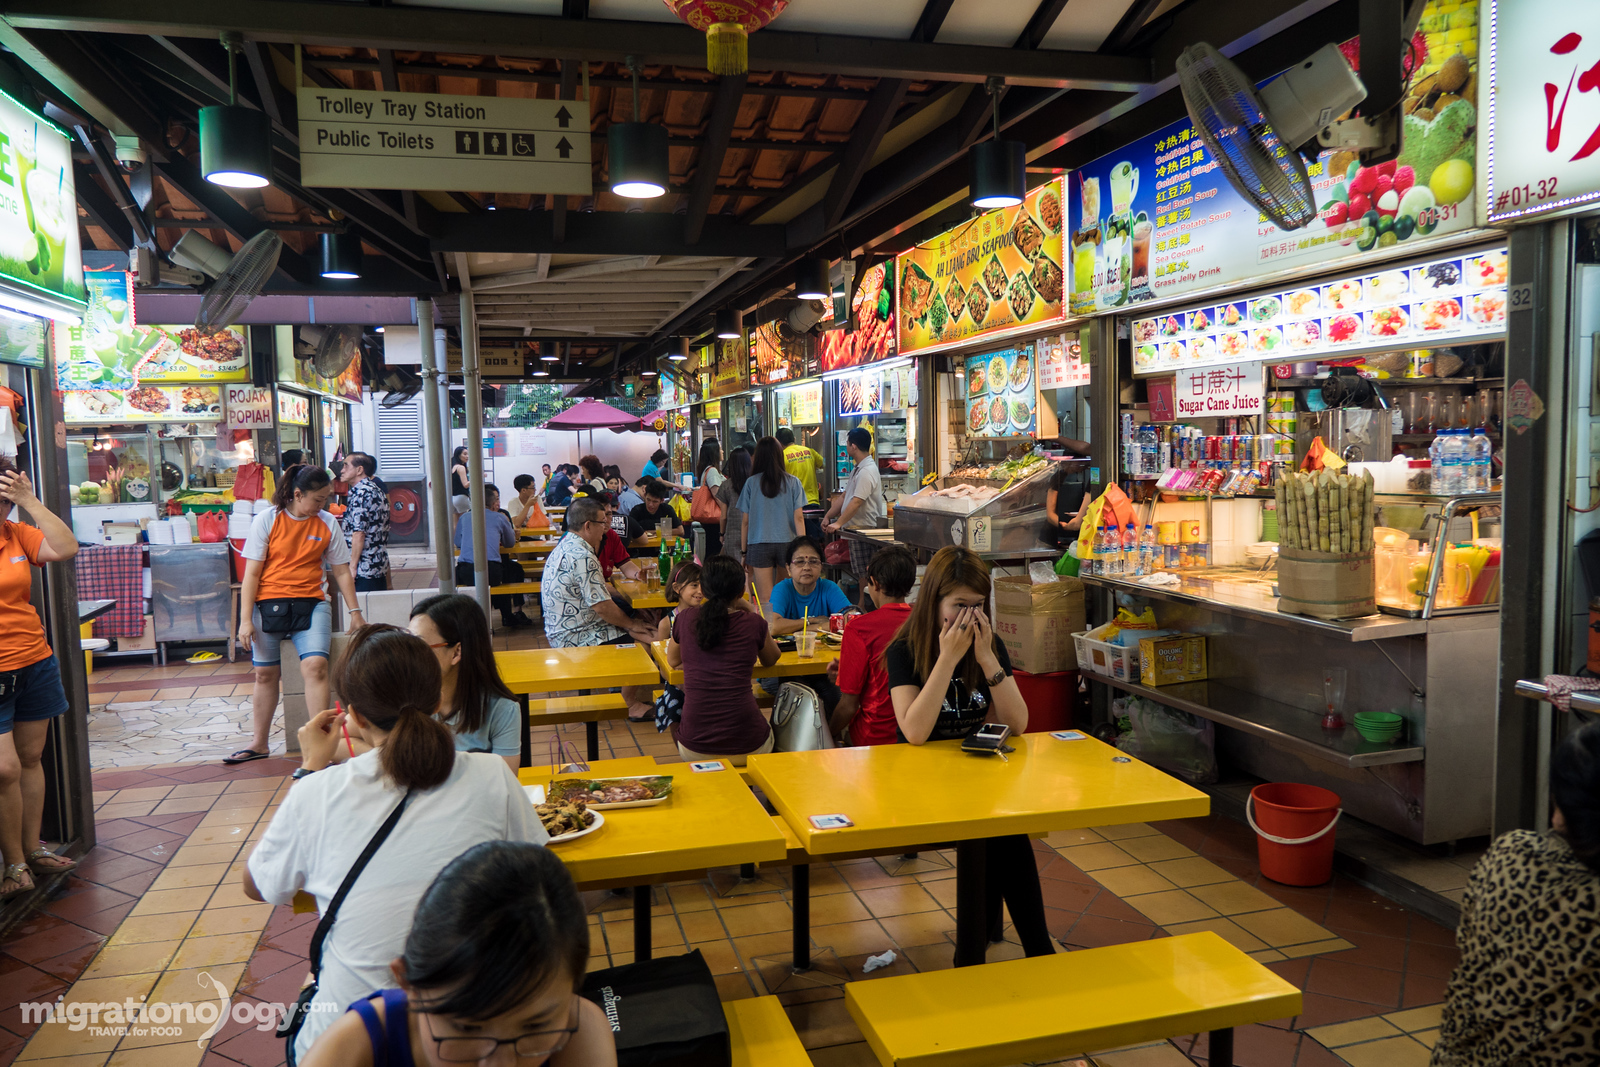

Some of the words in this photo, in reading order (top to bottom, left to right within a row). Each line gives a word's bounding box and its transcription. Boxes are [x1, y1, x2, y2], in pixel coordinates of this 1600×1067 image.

[316, 96, 374, 119] Trolley
[381, 99, 417, 120] Tray
[424, 101, 486, 120] Station
[317, 129, 370, 147] Public
[378, 132, 434, 150] Toilets
[1155, 144, 1190, 165] Cold/Hot
[1155, 149, 1204, 178] 冷热白果
[1156, 169, 1190, 190] Cold/Hot
[1311, 174, 1345, 191] ongan
[1156, 181, 1191, 204] 红豆汤
[1156, 204, 1171, 215] Red
[1173, 196, 1193, 209] Bean
[1195, 188, 1217, 201] Soup
[1496, 177, 1558, 211] #01-32
[1316, 206, 1339, 220] rink
[1418, 204, 1459, 227] 01-31
[1156, 227, 1178, 239] Sweet
[1180, 218, 1207, 231] Potato
[1208, 211, 1231, 223] Soup
[1155, 233, 1190, 253] 海底椰
[1260, 242, 1297, 260] 加料另计
[935, 261, 945, 278] AH
[945, 252, 965, 276] LIANG
[966, 245, 980, 267] BBQ
[981, 231, 1015, 257] SEAFOOD
[1155, 255, 1169, 264] Sea
[1171, 245, 1204, 259] Coconut
[1154, 277, 1176, 288] Grass
[1178, 271, 1196, 283] Jelly
[1198, 266, 1221, 278] Drink
[1155, 259, 1189, 278] 仙草水
[1512, 288, 1531, 306] 32
[67, 325, 88, 381] 甘蔗王
[1091, 353, 1097, 364] 31
[1189, 366, 1246, 396] 甘蔗汁
[229, 389, 267, 403] ROJAK
[1155, 390, 1168, 411] A
[1179, 398, 1205, 415] Sugar
[1207, 396, 1230, 411] Cane
[1232, 394, 1259, 411] Juice
[229, 409, 270, 424] POPIAH
[109, 438, 127, 448] Min
[1158, 646, 1183, 656] OOLONG
